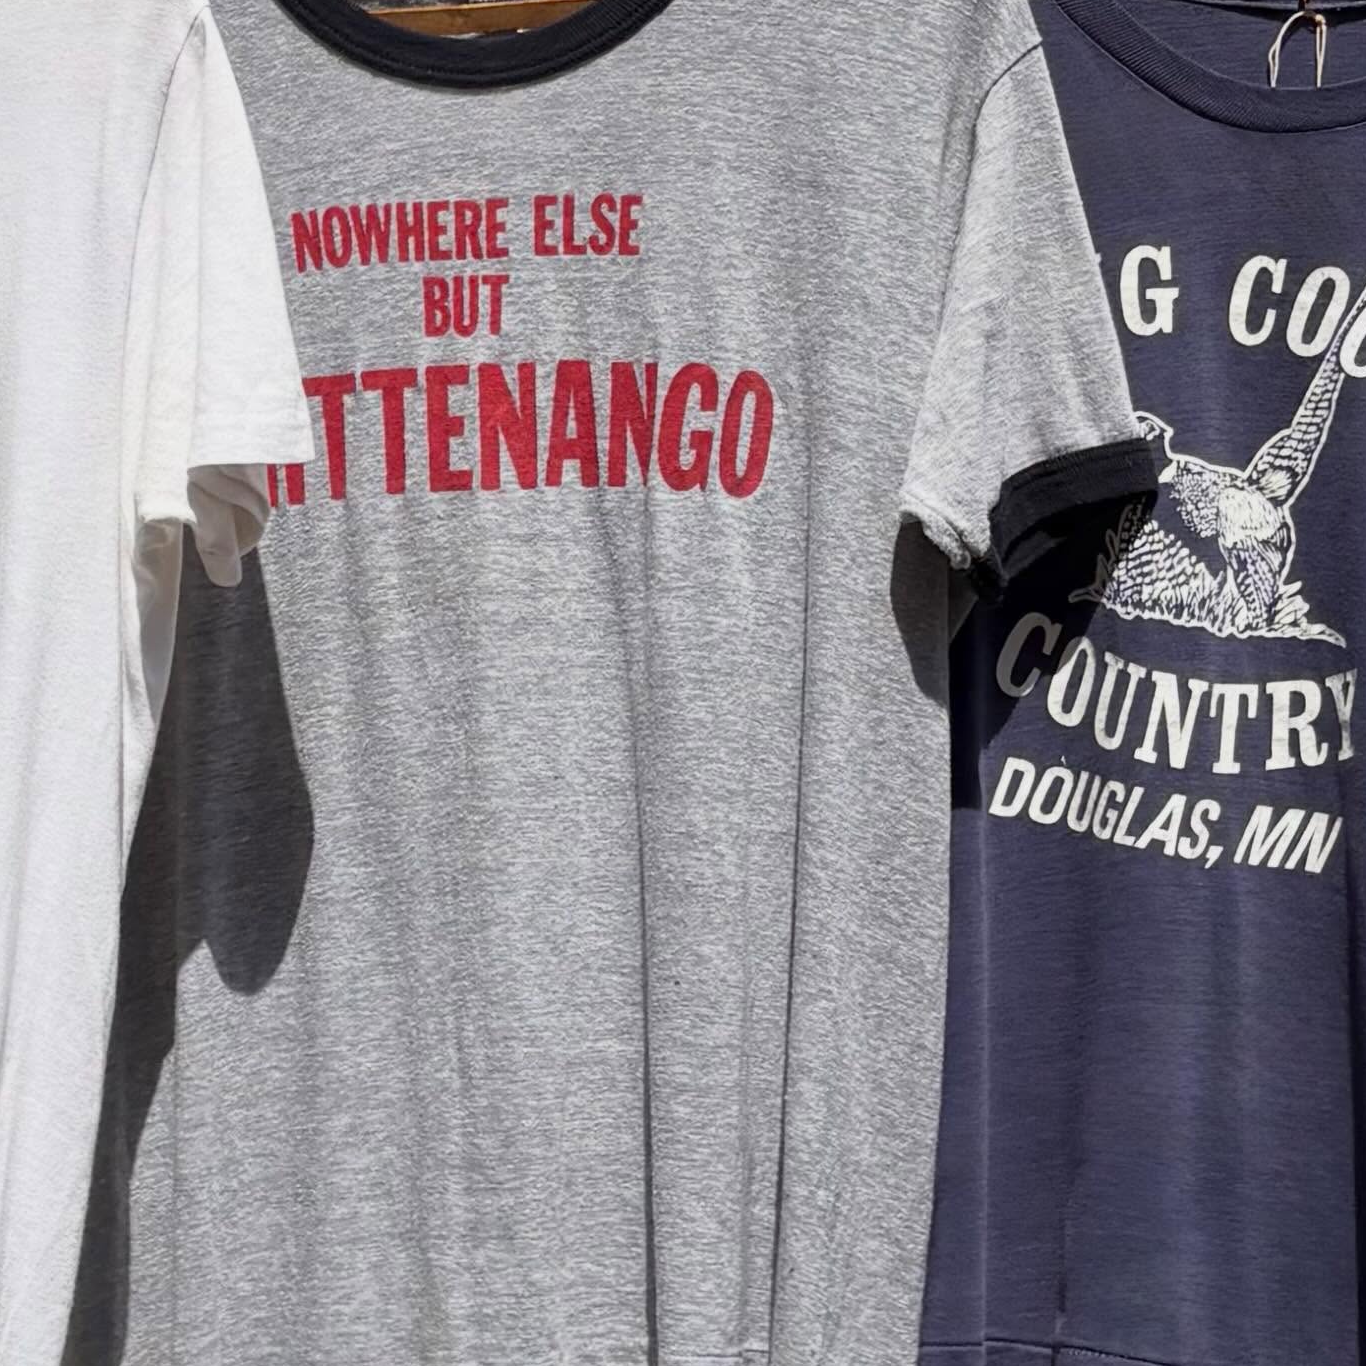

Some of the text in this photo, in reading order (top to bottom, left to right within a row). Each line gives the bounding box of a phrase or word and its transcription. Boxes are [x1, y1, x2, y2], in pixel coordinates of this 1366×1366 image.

[290, 193, 643, 272] NOWHERE ELSE
[422, 274, 509, 337] BUT
[267, 359, 773, 509] TTENANGO
[995, 611, 1358, 777] COUNTRY
[988, 756, 1344, 875] DOUGLAS, MN
